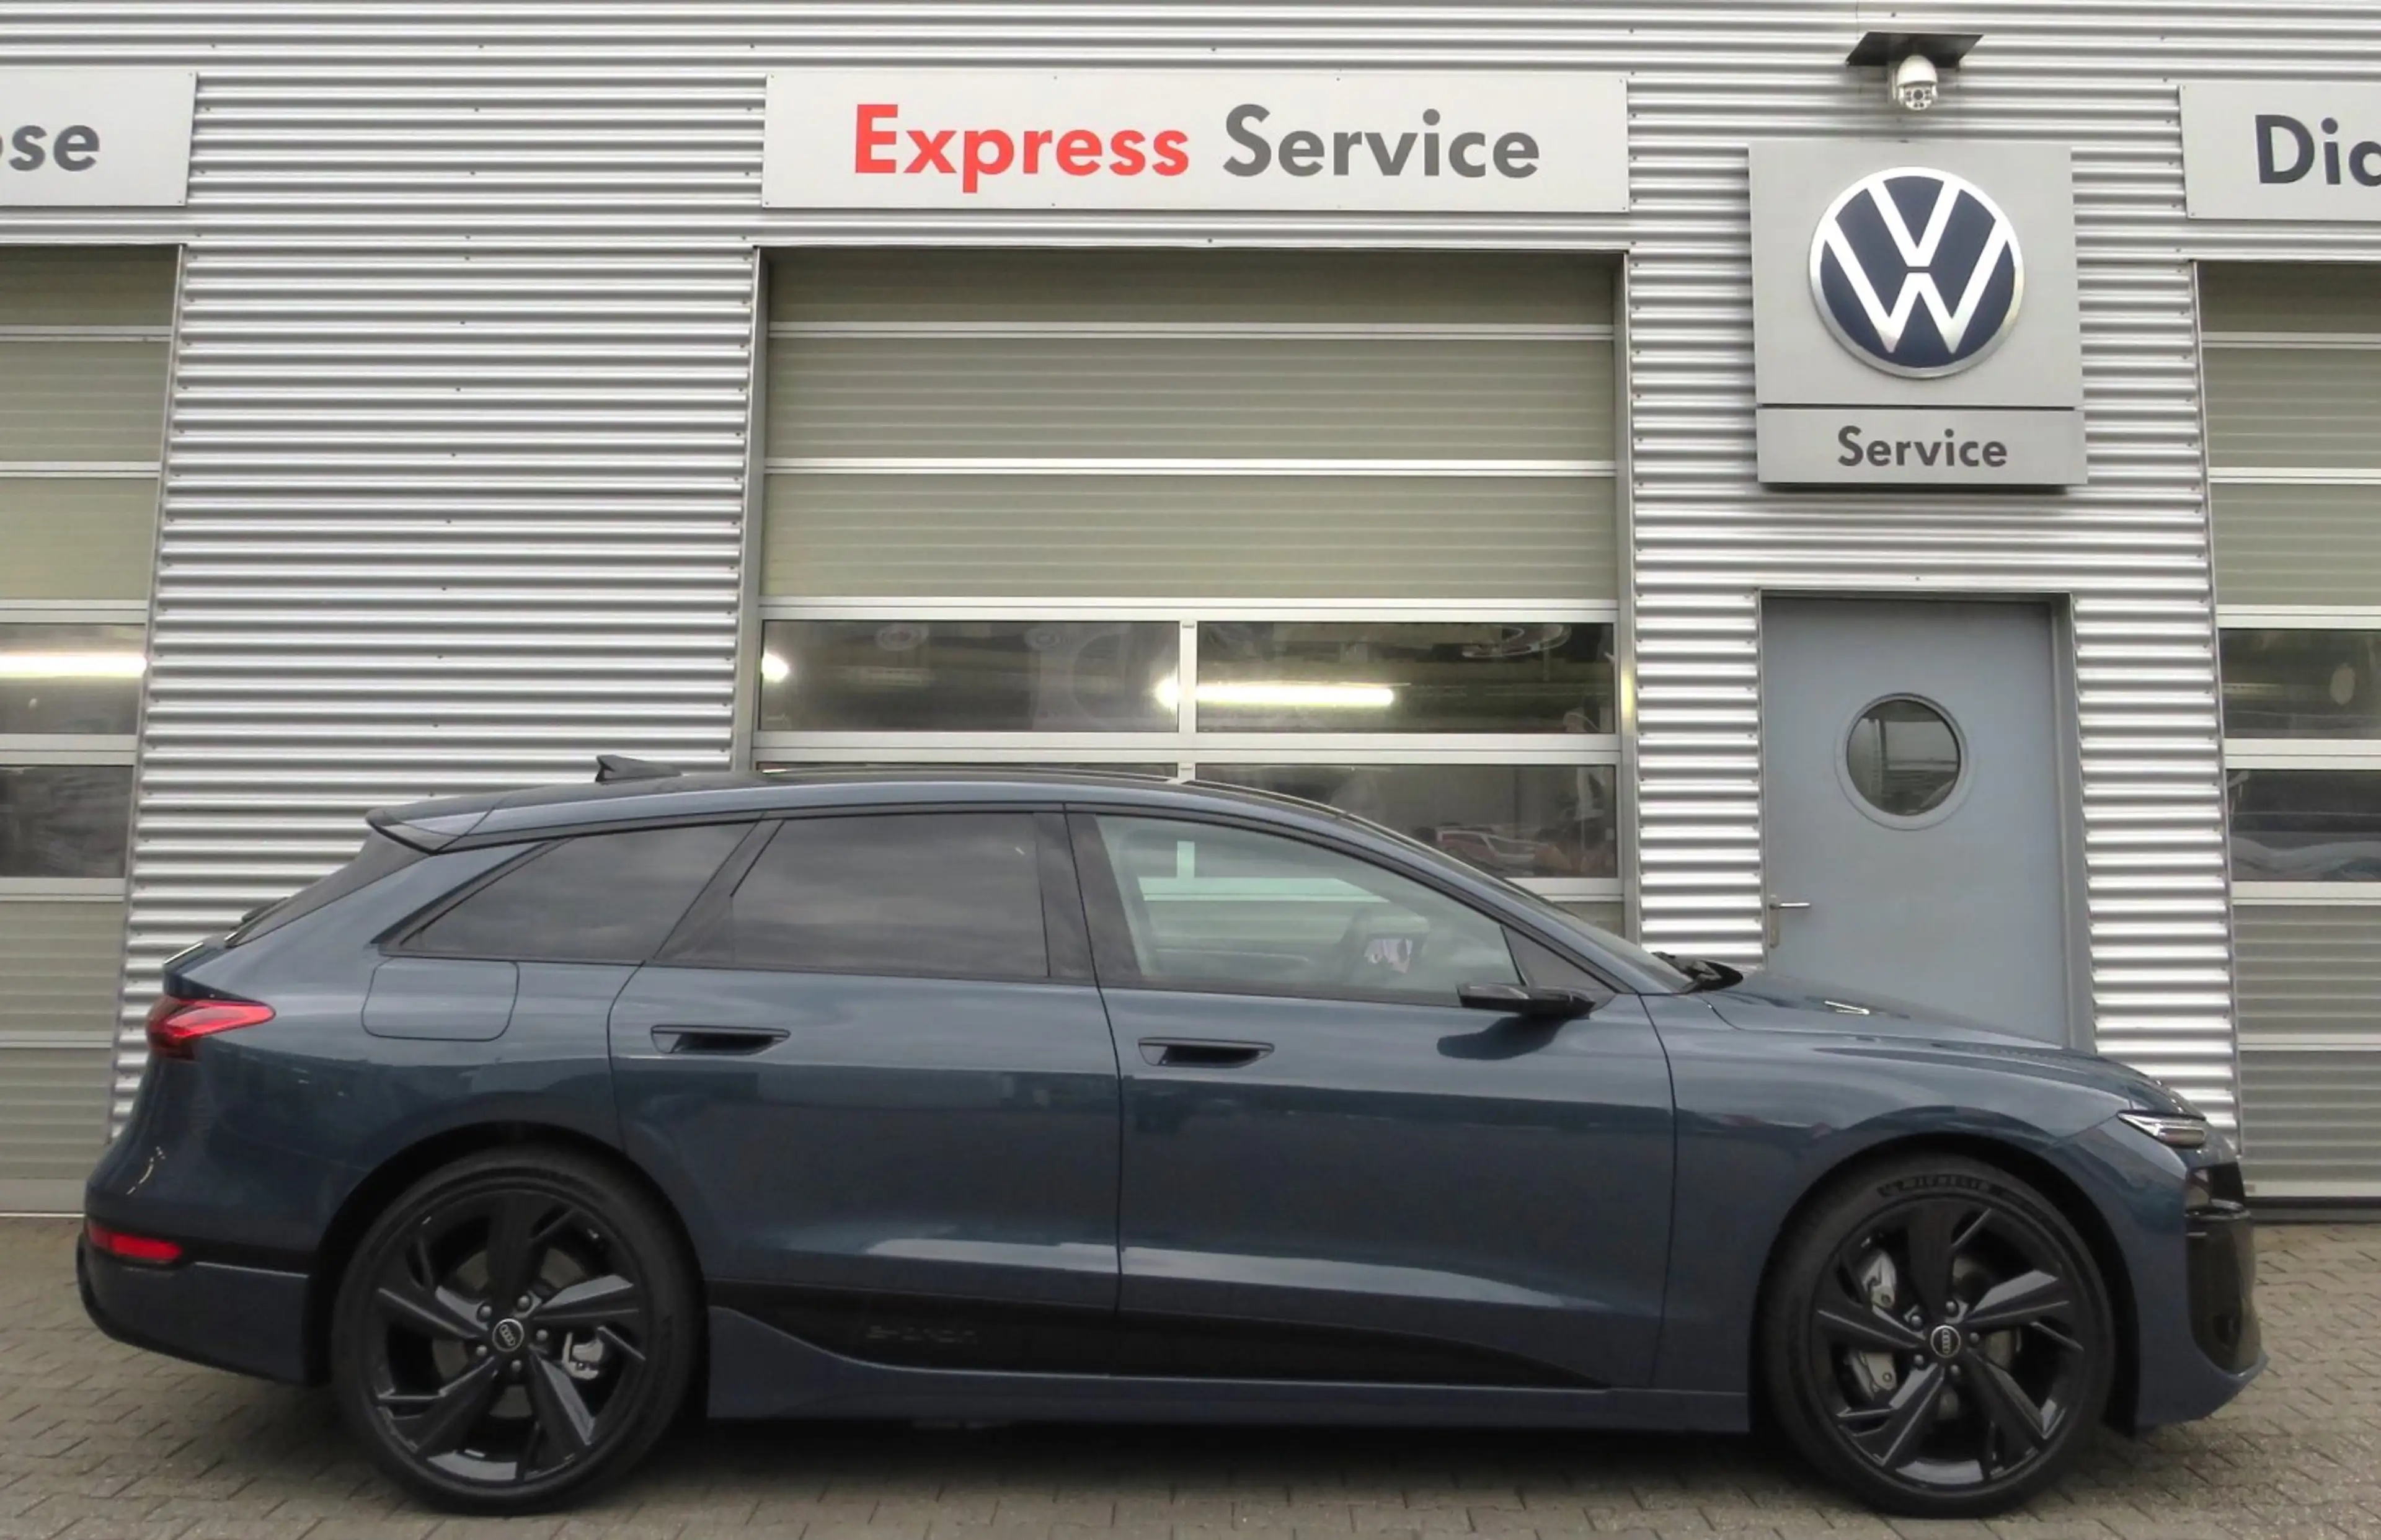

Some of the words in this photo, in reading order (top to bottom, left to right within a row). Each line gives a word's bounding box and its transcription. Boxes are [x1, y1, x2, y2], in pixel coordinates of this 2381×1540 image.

[0, 125, 100, 172] se
[854, 104, 1190, 194] Express
[1223, 104, 1540, 178] Service
[1837, 425, 2008, 468] Service
